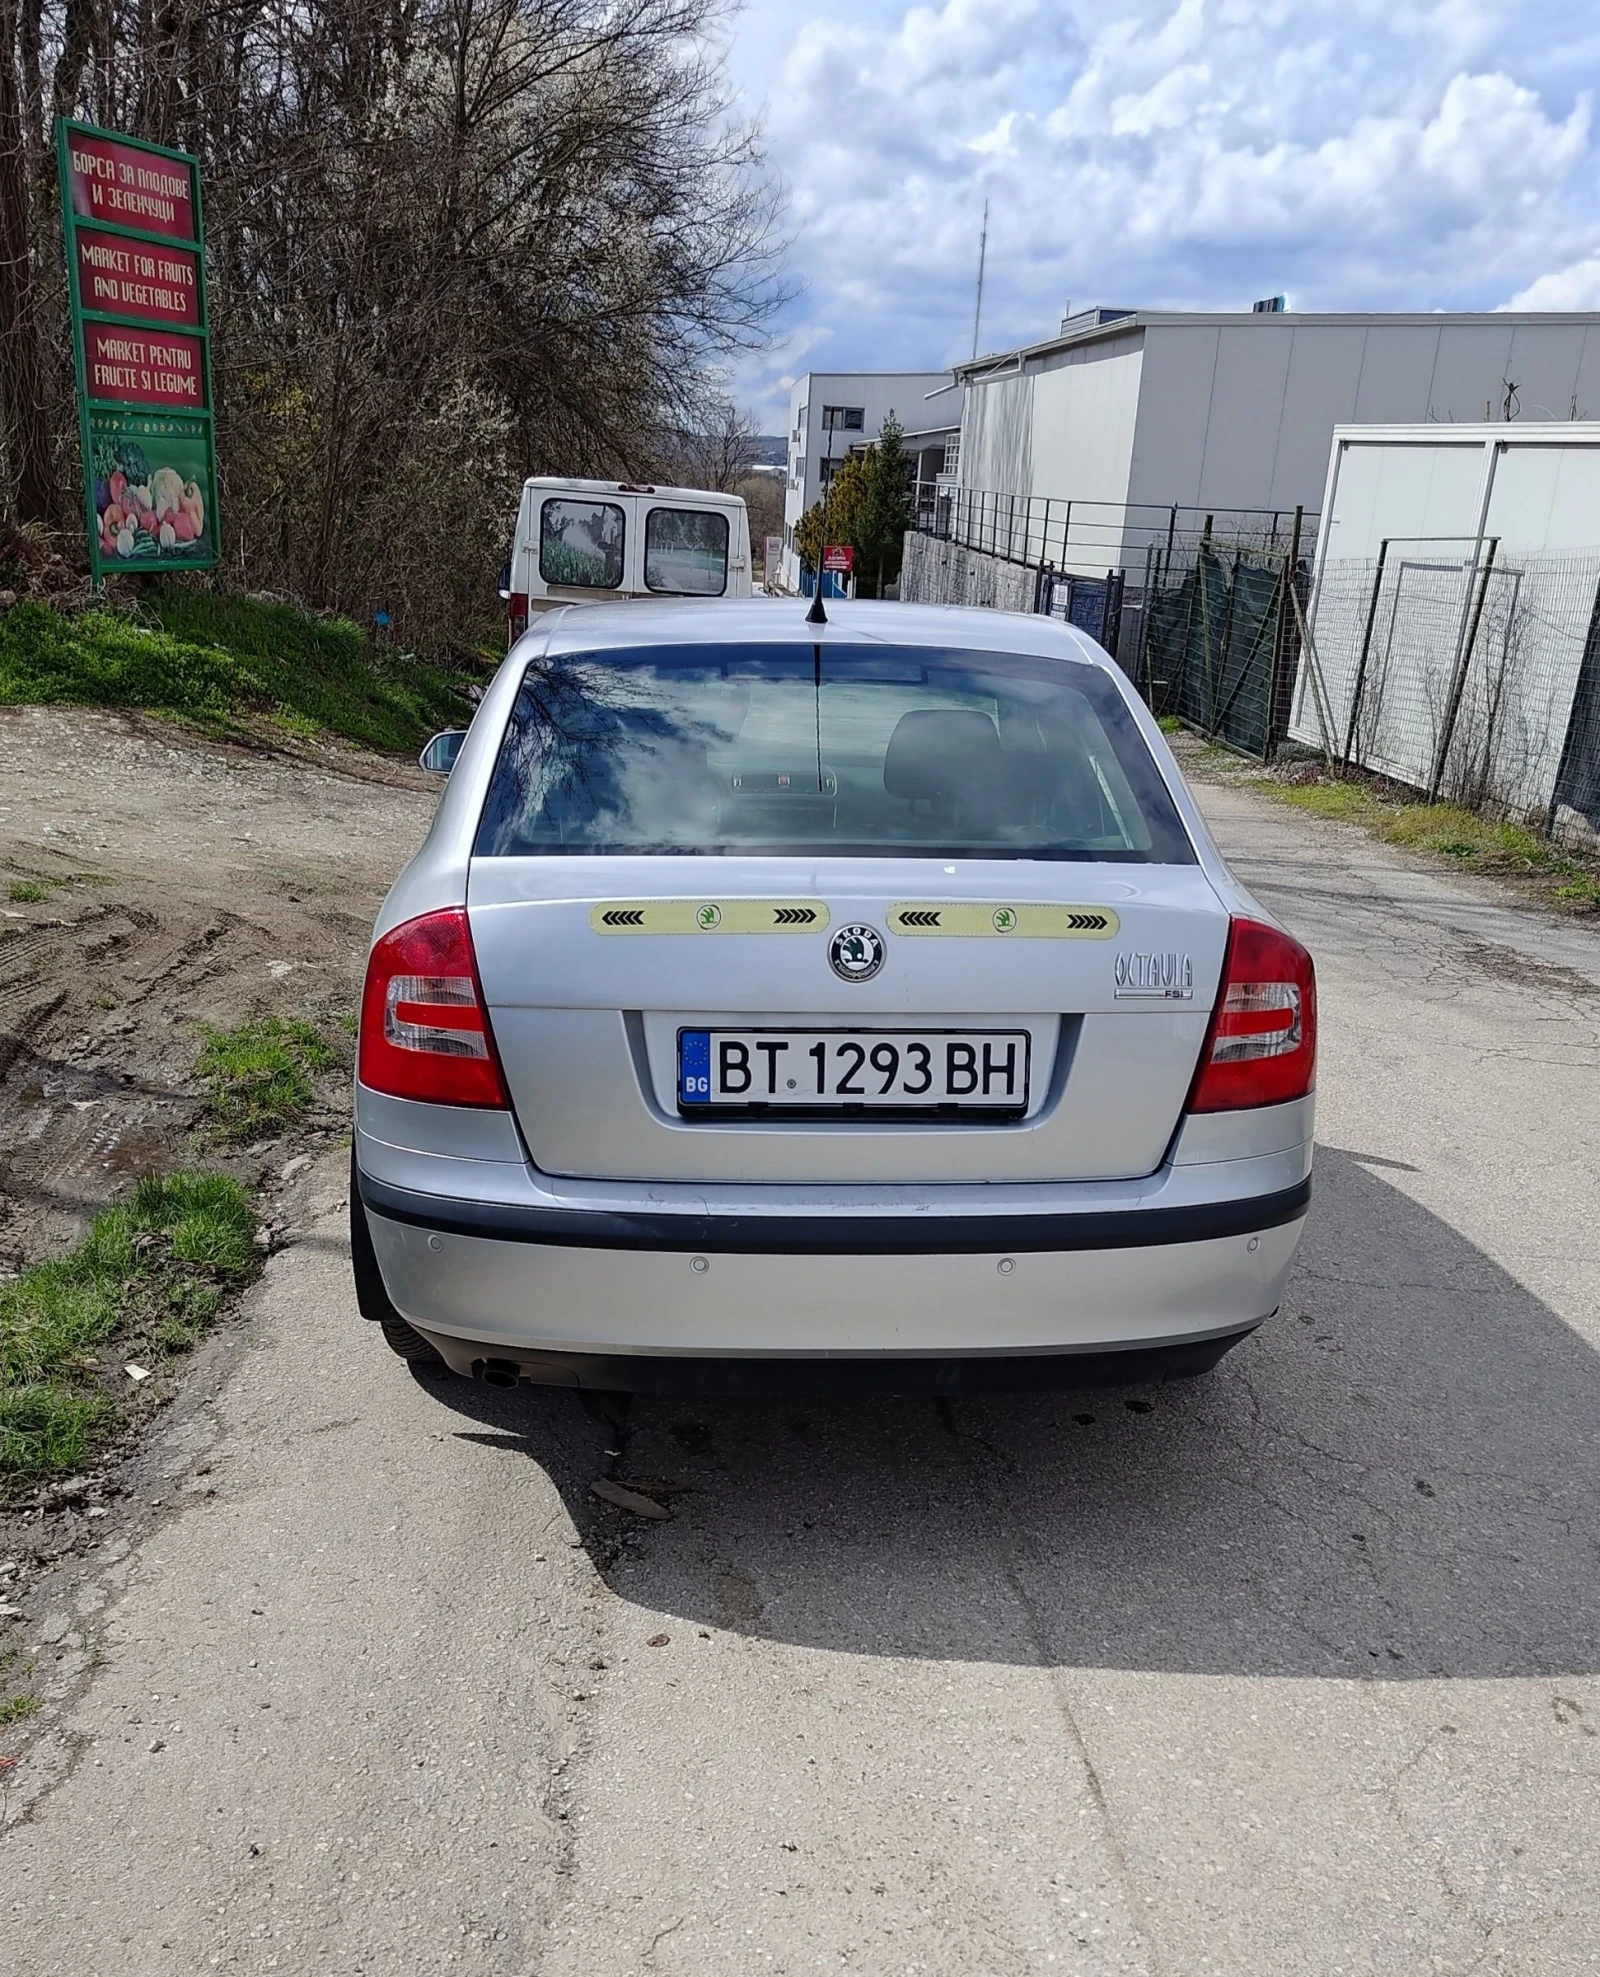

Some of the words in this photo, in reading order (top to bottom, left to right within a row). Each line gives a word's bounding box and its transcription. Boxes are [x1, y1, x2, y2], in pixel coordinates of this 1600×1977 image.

[73, 151, 116, 181] БОРСА
[118, 163, 135, 186] ЗА
[137, 168, 188, 200] ПЛОДОВЕ
[92, 183, 103, 205] И
[108, 187, 175, 223] ЗЕЛЕНЧУЦИ
[81, 244, 130, 274] MARKET
[134, 254, 156, 279] FOR
[158, 261, 194, 286] FRUITS
[94, 276, 118, 300] AND
[121, 282, 187, 312] VEGETABLES
[97, 338, 145, 365] MARKET
[149, 346, 192, 370] PENTRU
[94, 364, 138, 389] FRUCTE
[141, 370, 152, 391] SI
[154, 373, 198, 396] LEGUME
[1114, 952, 1193, 987] OCTAVIA
[1164, 990, 1184, 998] FSI
[685, 1076, 709, 1093] BG
[718, 1041, 789, 1095] BT
